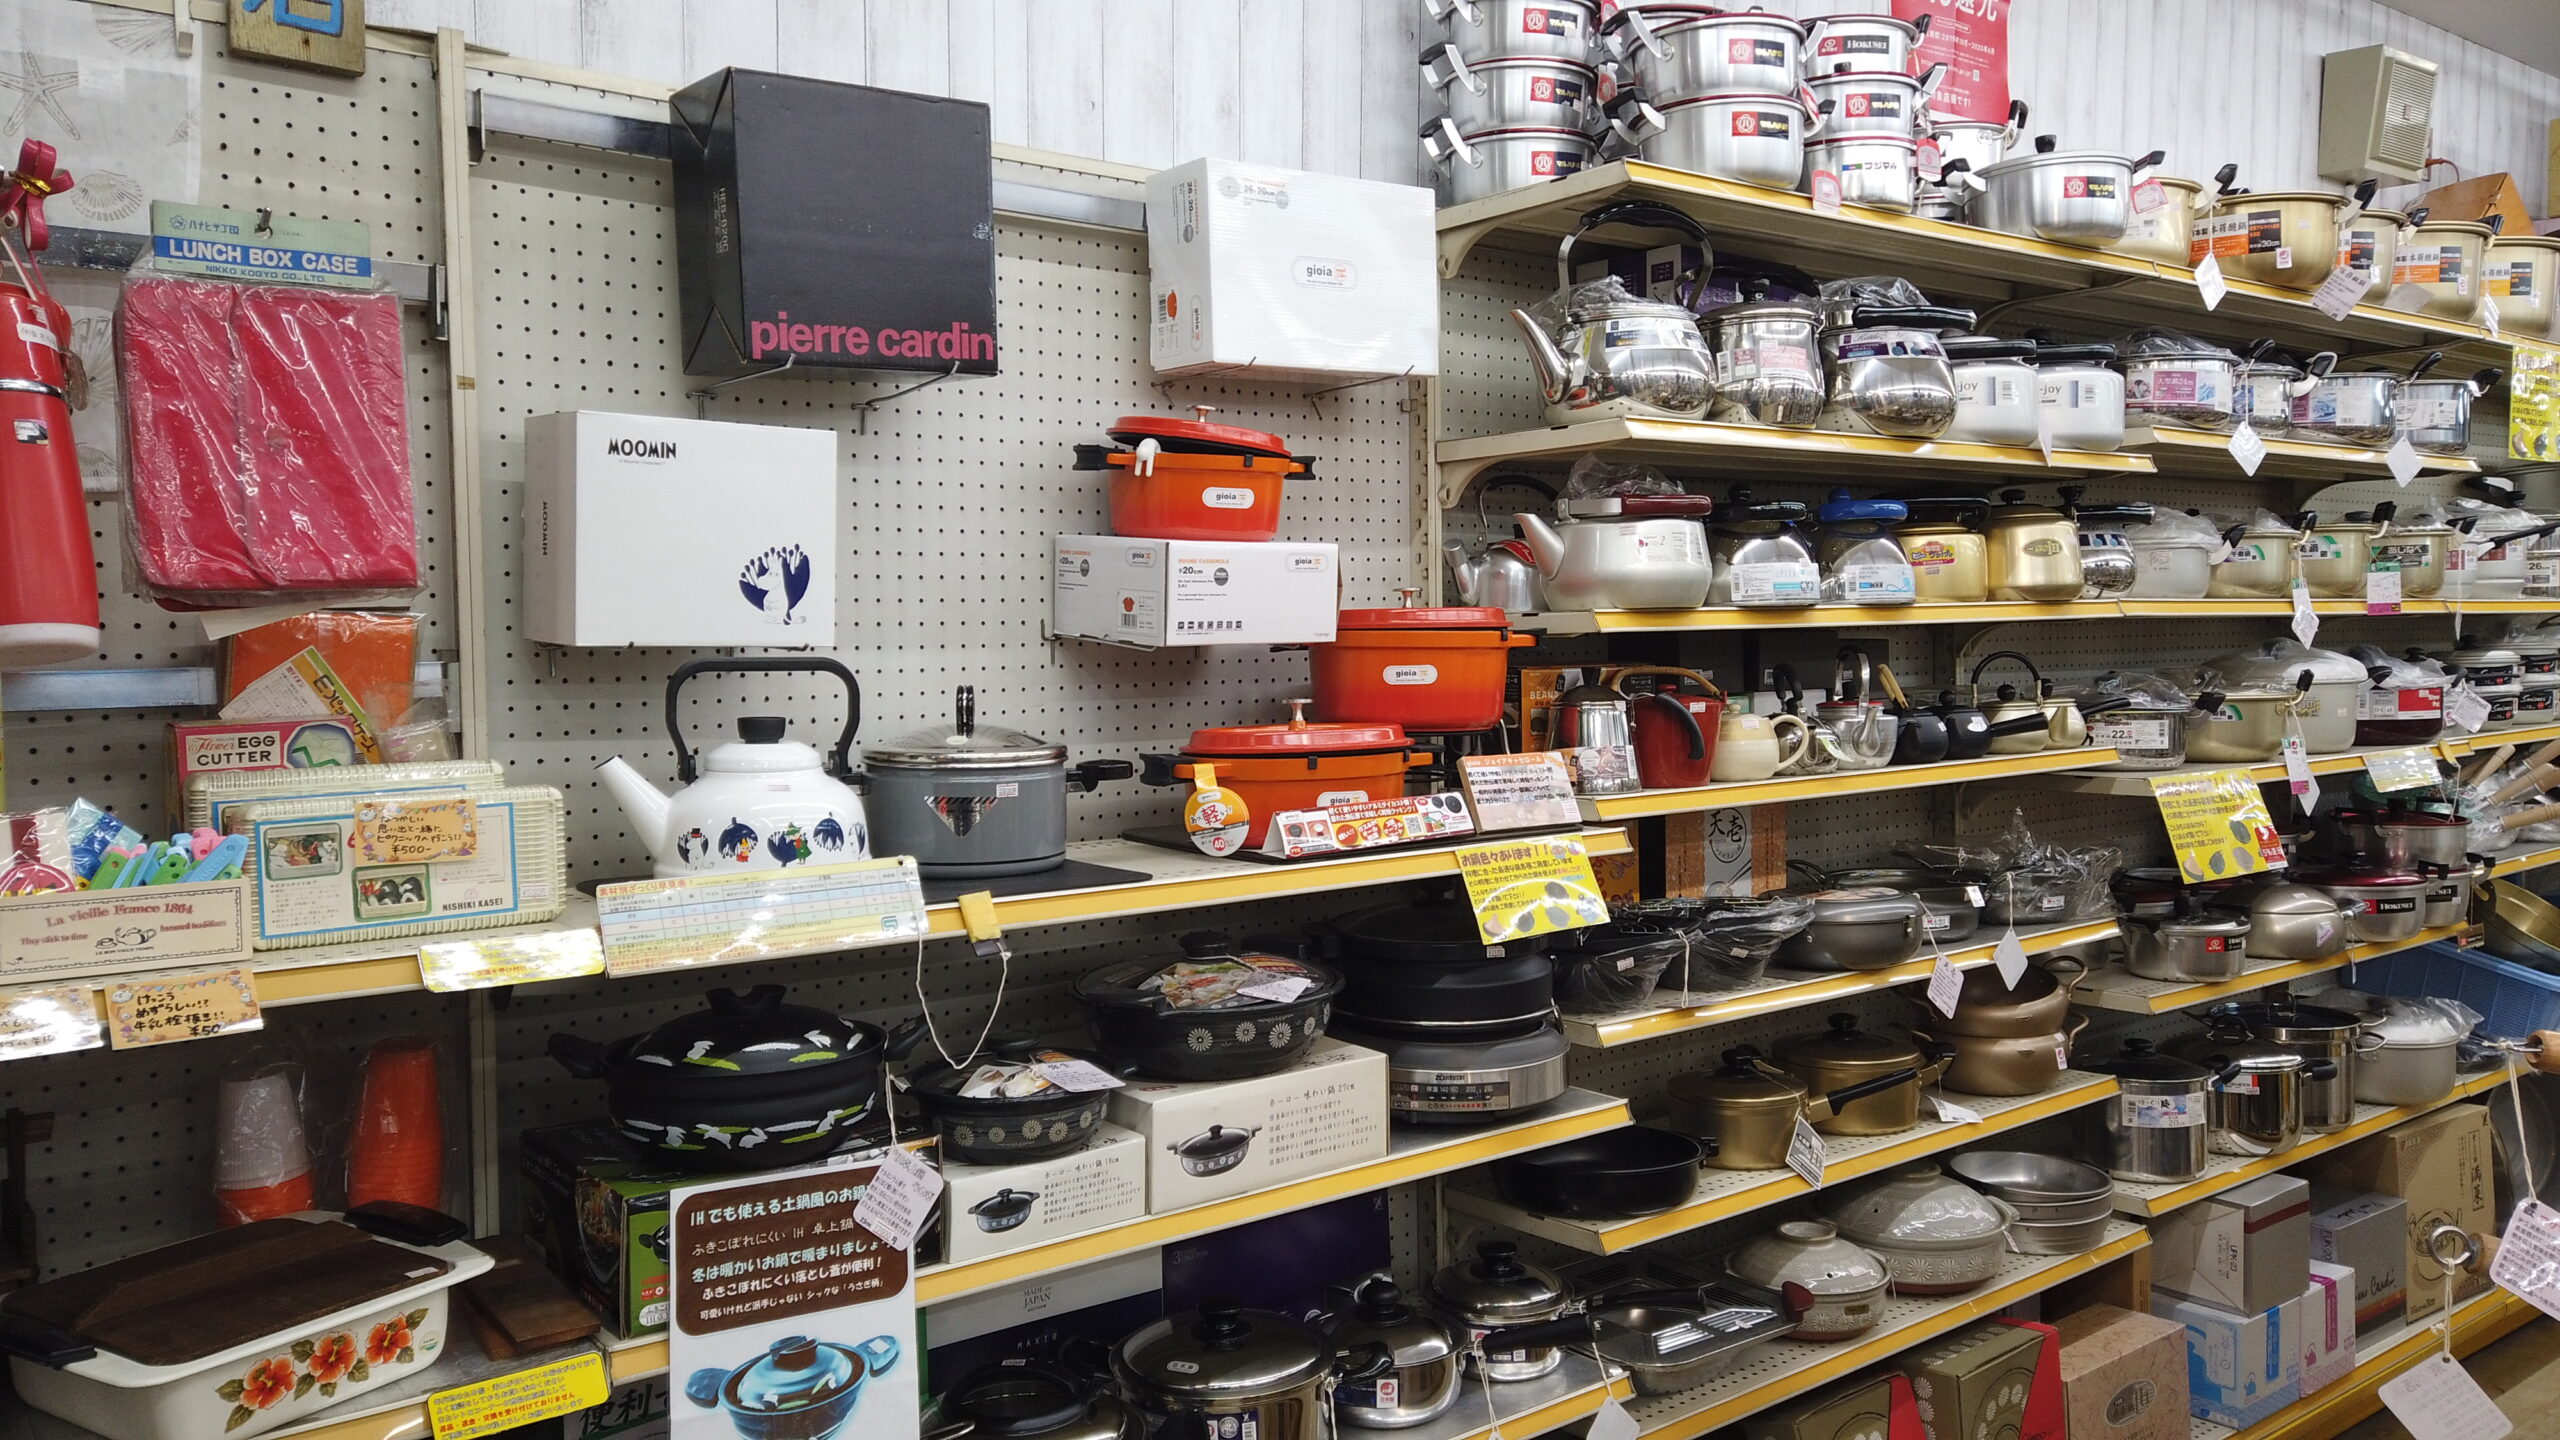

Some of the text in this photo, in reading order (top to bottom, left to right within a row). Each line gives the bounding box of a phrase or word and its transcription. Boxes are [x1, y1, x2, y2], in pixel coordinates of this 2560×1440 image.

[1847, 39, 1887, 49] HOKUSEI
[1864, 161, 1897, 170] フジマル
[169, 238, 359, 275] LUNCH BOX CASE
[205, 264, 237, 276] NIKKO
[1307, 264, 1333, 277] gioia
[751, 311, 994, 361] pierre cardin
[607, 437, 677, 460] MOOMIN
[1215, 492, 1237, 504] gioia
[1131, 552, 1144, 560] gioia
[1294, 557, 1312, 566] gioia
[1395, 669, 1417, 679] gioia
[237, 735, 276, 749] EGG
[196, 750, 272, 766] CUTTER
[1330, 796, 1351, 806] gioia
[379, 815, 424, 823] なつかしい
[377, 824, 442, 834] 思い出と一緒に
[1213, 839, 1225, 848] 40
[442, 898, 504, 912] NISHIKI KASEI
[2380, 902, 2413, 911] HOKUSEI
[46, 902, 194, 928] La vieille France 1864
[137, 992, 175, 1006] けっこう
[189, 1024, 221, 1036] ¥50
[1338, 1083, 1355, 1093] 27cm
[690, 1211, 705, 1227] IH
[710, 1185, 870, 1225] でも使える土鍋風のお鍋
[792, 1228, 804, 1239] IH
[811, 1218, 854, 1236] 卓上鍋
[1023, 1287, 1044, 1298] MADE
[700, 1292, 803, 1321] 可愛いけれど派手じゃない
[1023, 1292, 1052, 1309] JAPAN
[439, 1391, 575, 1433] 返品・返金・交換を受け付けておりません
